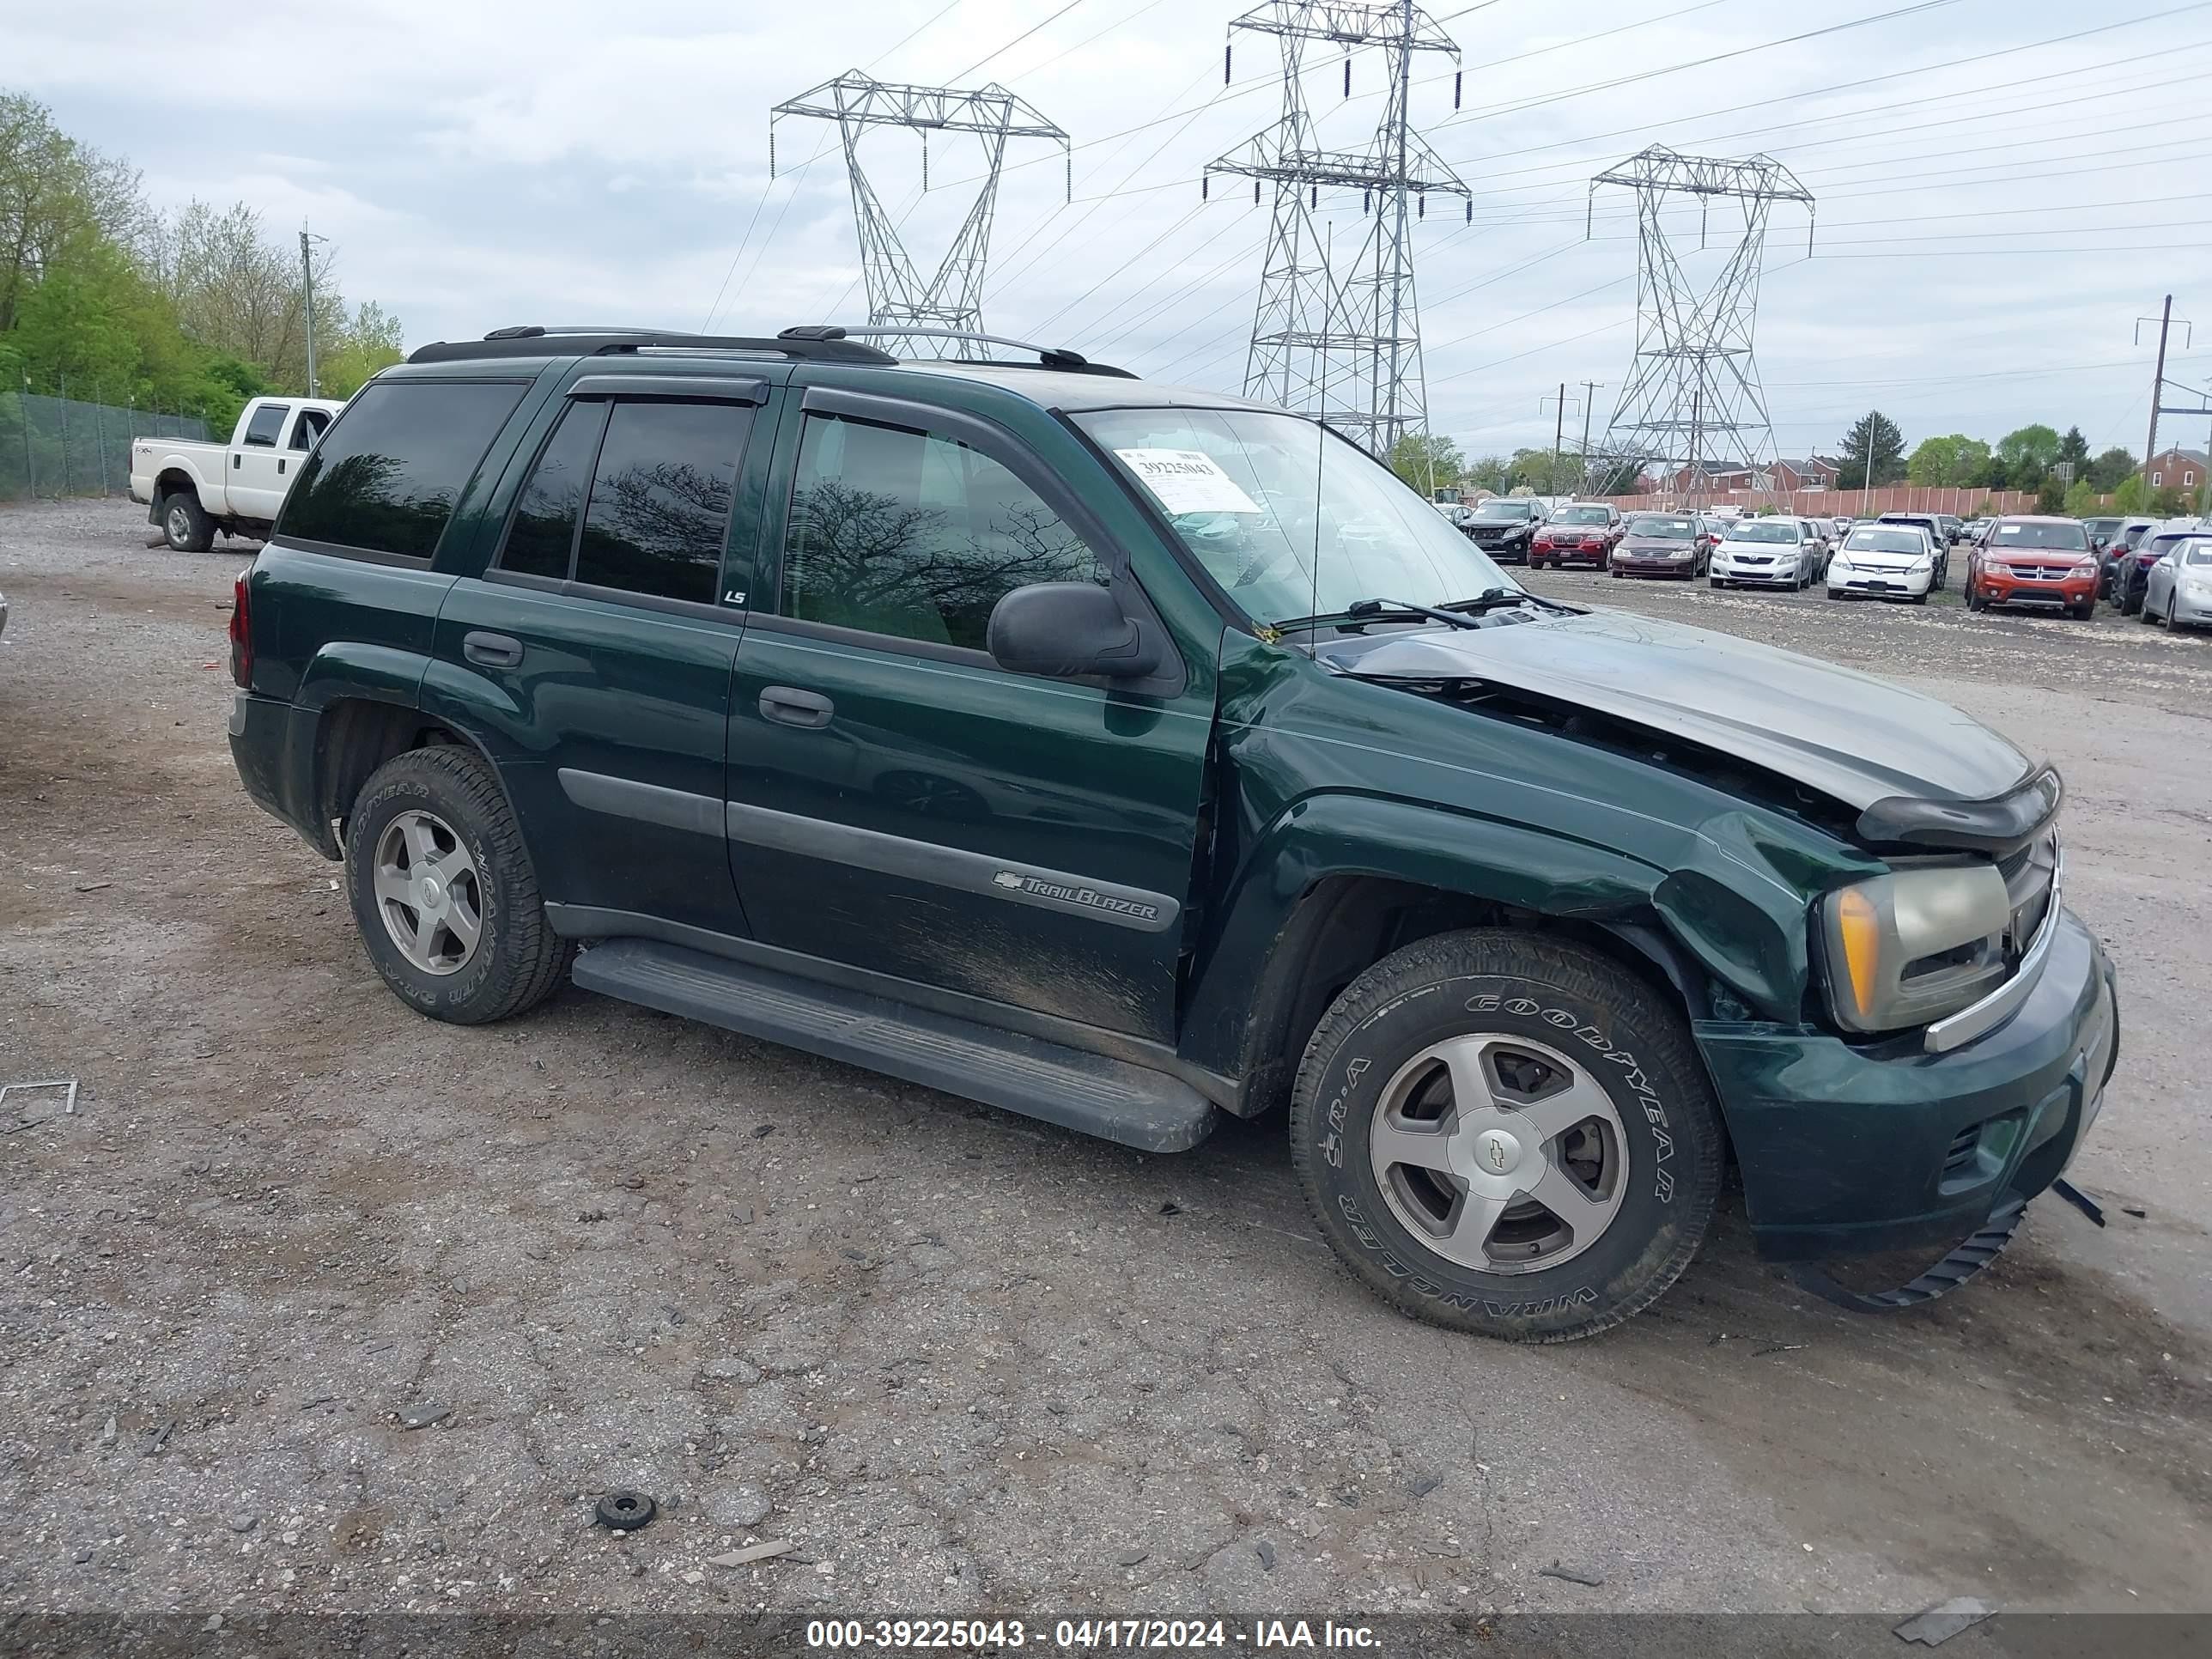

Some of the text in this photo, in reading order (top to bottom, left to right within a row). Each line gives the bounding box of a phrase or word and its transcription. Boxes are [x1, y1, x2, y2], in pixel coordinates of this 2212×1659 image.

[1139, 462, 1215, 476] 39225043
[724, 590, 746, 604] LS
[1464, 994, 1675, 1204] GOODYEAR
[1338, 1194, 1600, 1318] WRANGLER
